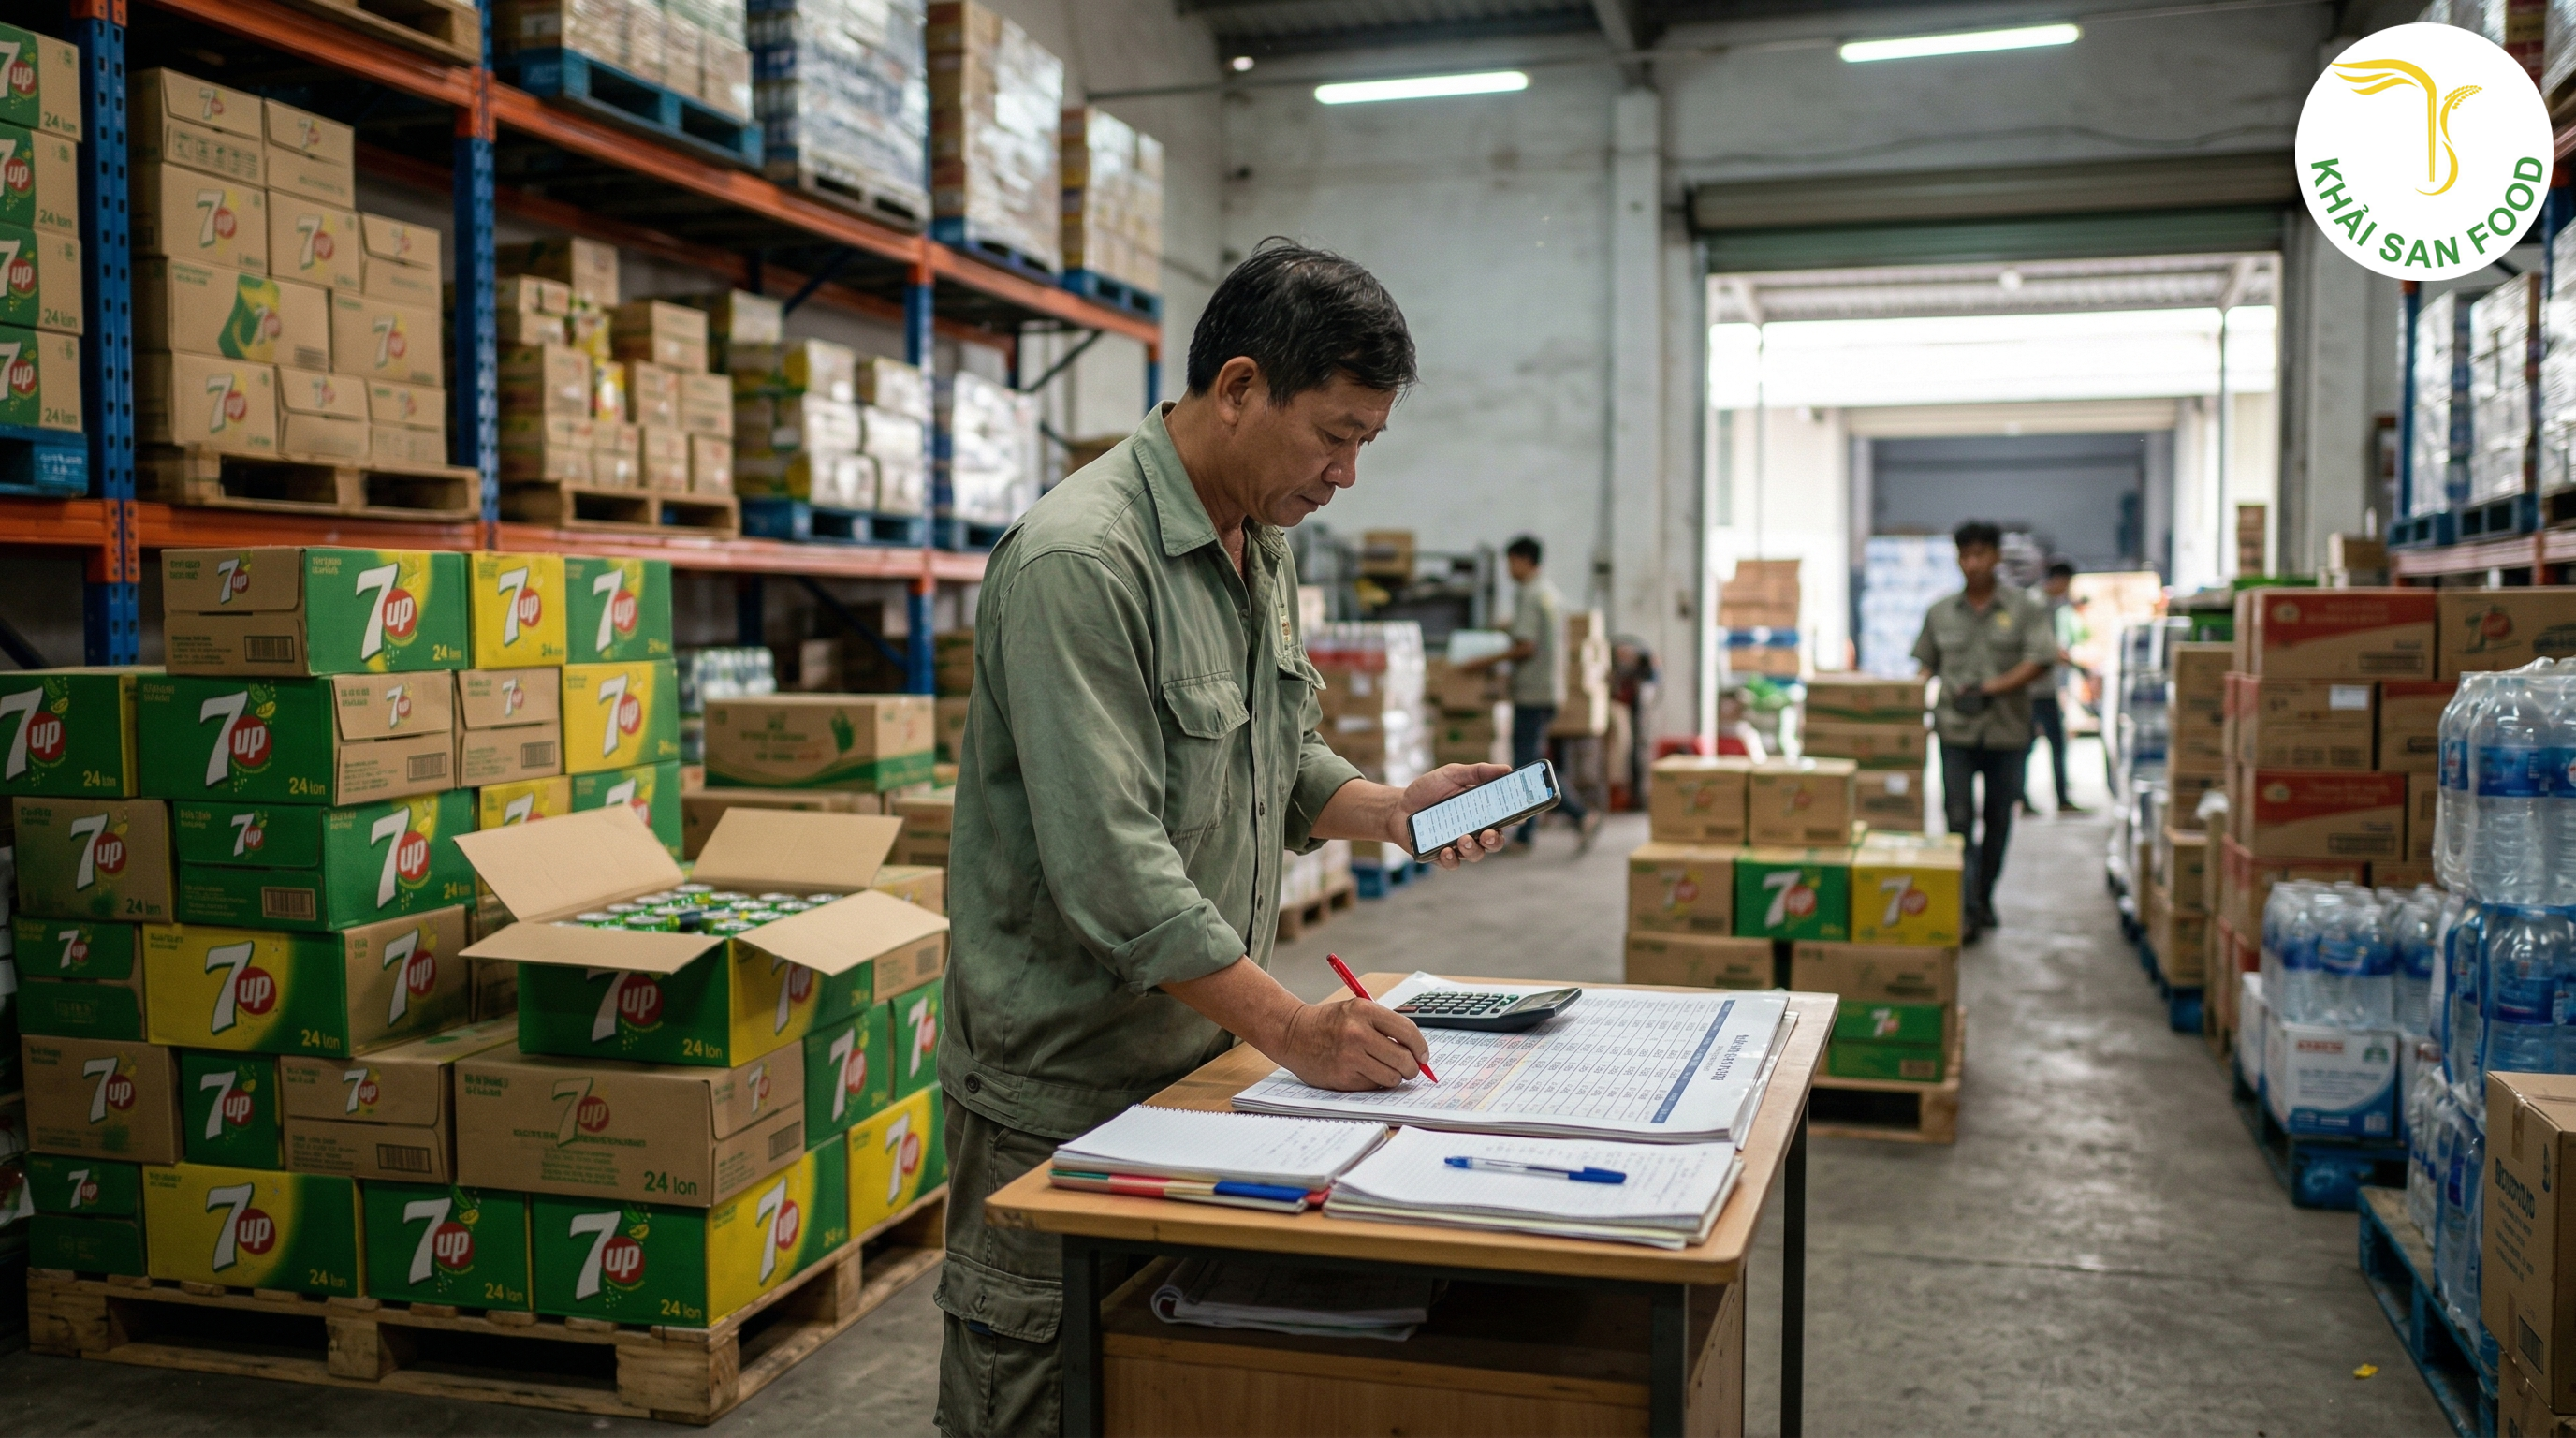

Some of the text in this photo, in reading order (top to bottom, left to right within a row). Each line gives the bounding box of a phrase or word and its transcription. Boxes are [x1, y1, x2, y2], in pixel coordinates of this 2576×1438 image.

[432, 644, 447, 661] 24
[83, 770, 100, 786] 24
[289, 777, 307, 794] 24
[126, 898, 143, 915] 24
[301, 1030, 320, 1048] 24
[682, 1039, 702, 1057] 24
[644, 1171, 697, 1196] 24 lon
[309, 1269, 328, 1285] 24
[484, 1283, 504, 1299] 24
[660, 1299, 681, 1316] 24
